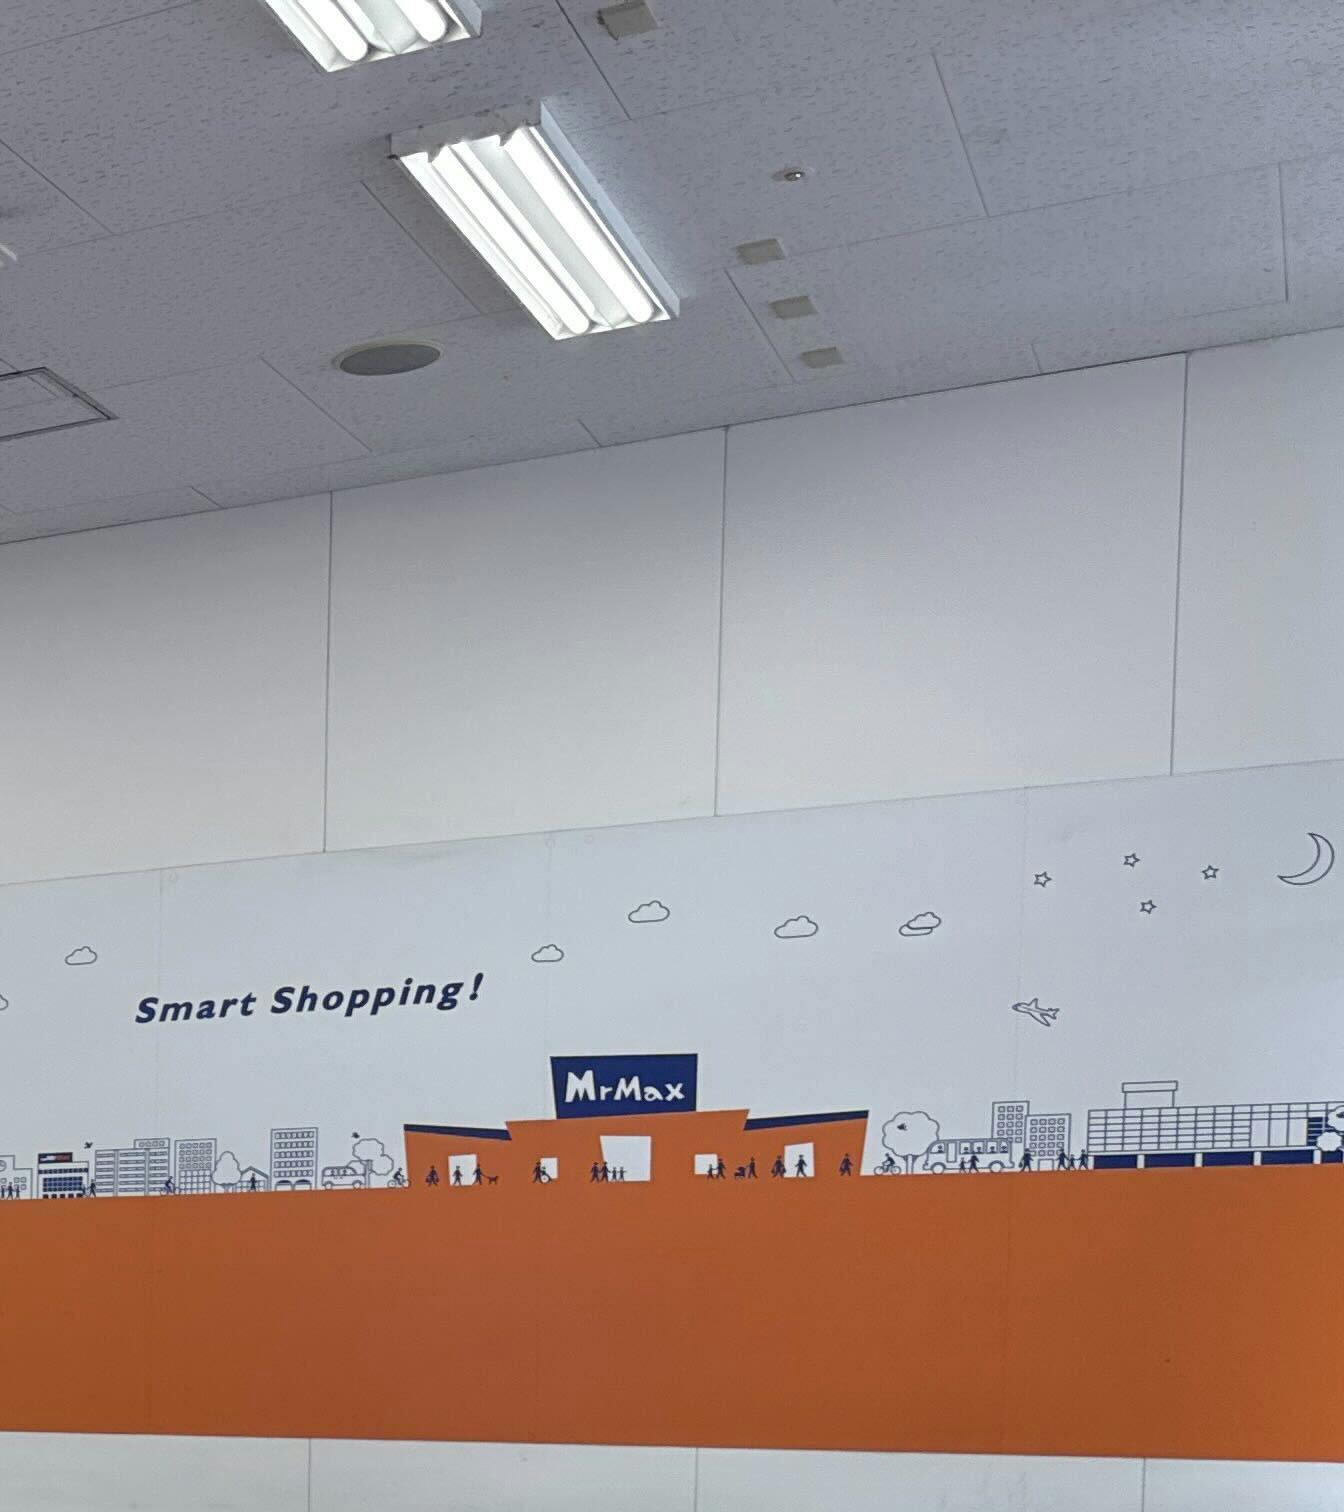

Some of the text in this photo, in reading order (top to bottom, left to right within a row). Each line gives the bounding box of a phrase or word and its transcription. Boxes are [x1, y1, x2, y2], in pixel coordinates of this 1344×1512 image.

[134, 972, 485, 1025] Smart Shopping!
[563, 1070, 685, 1106] MrMax
